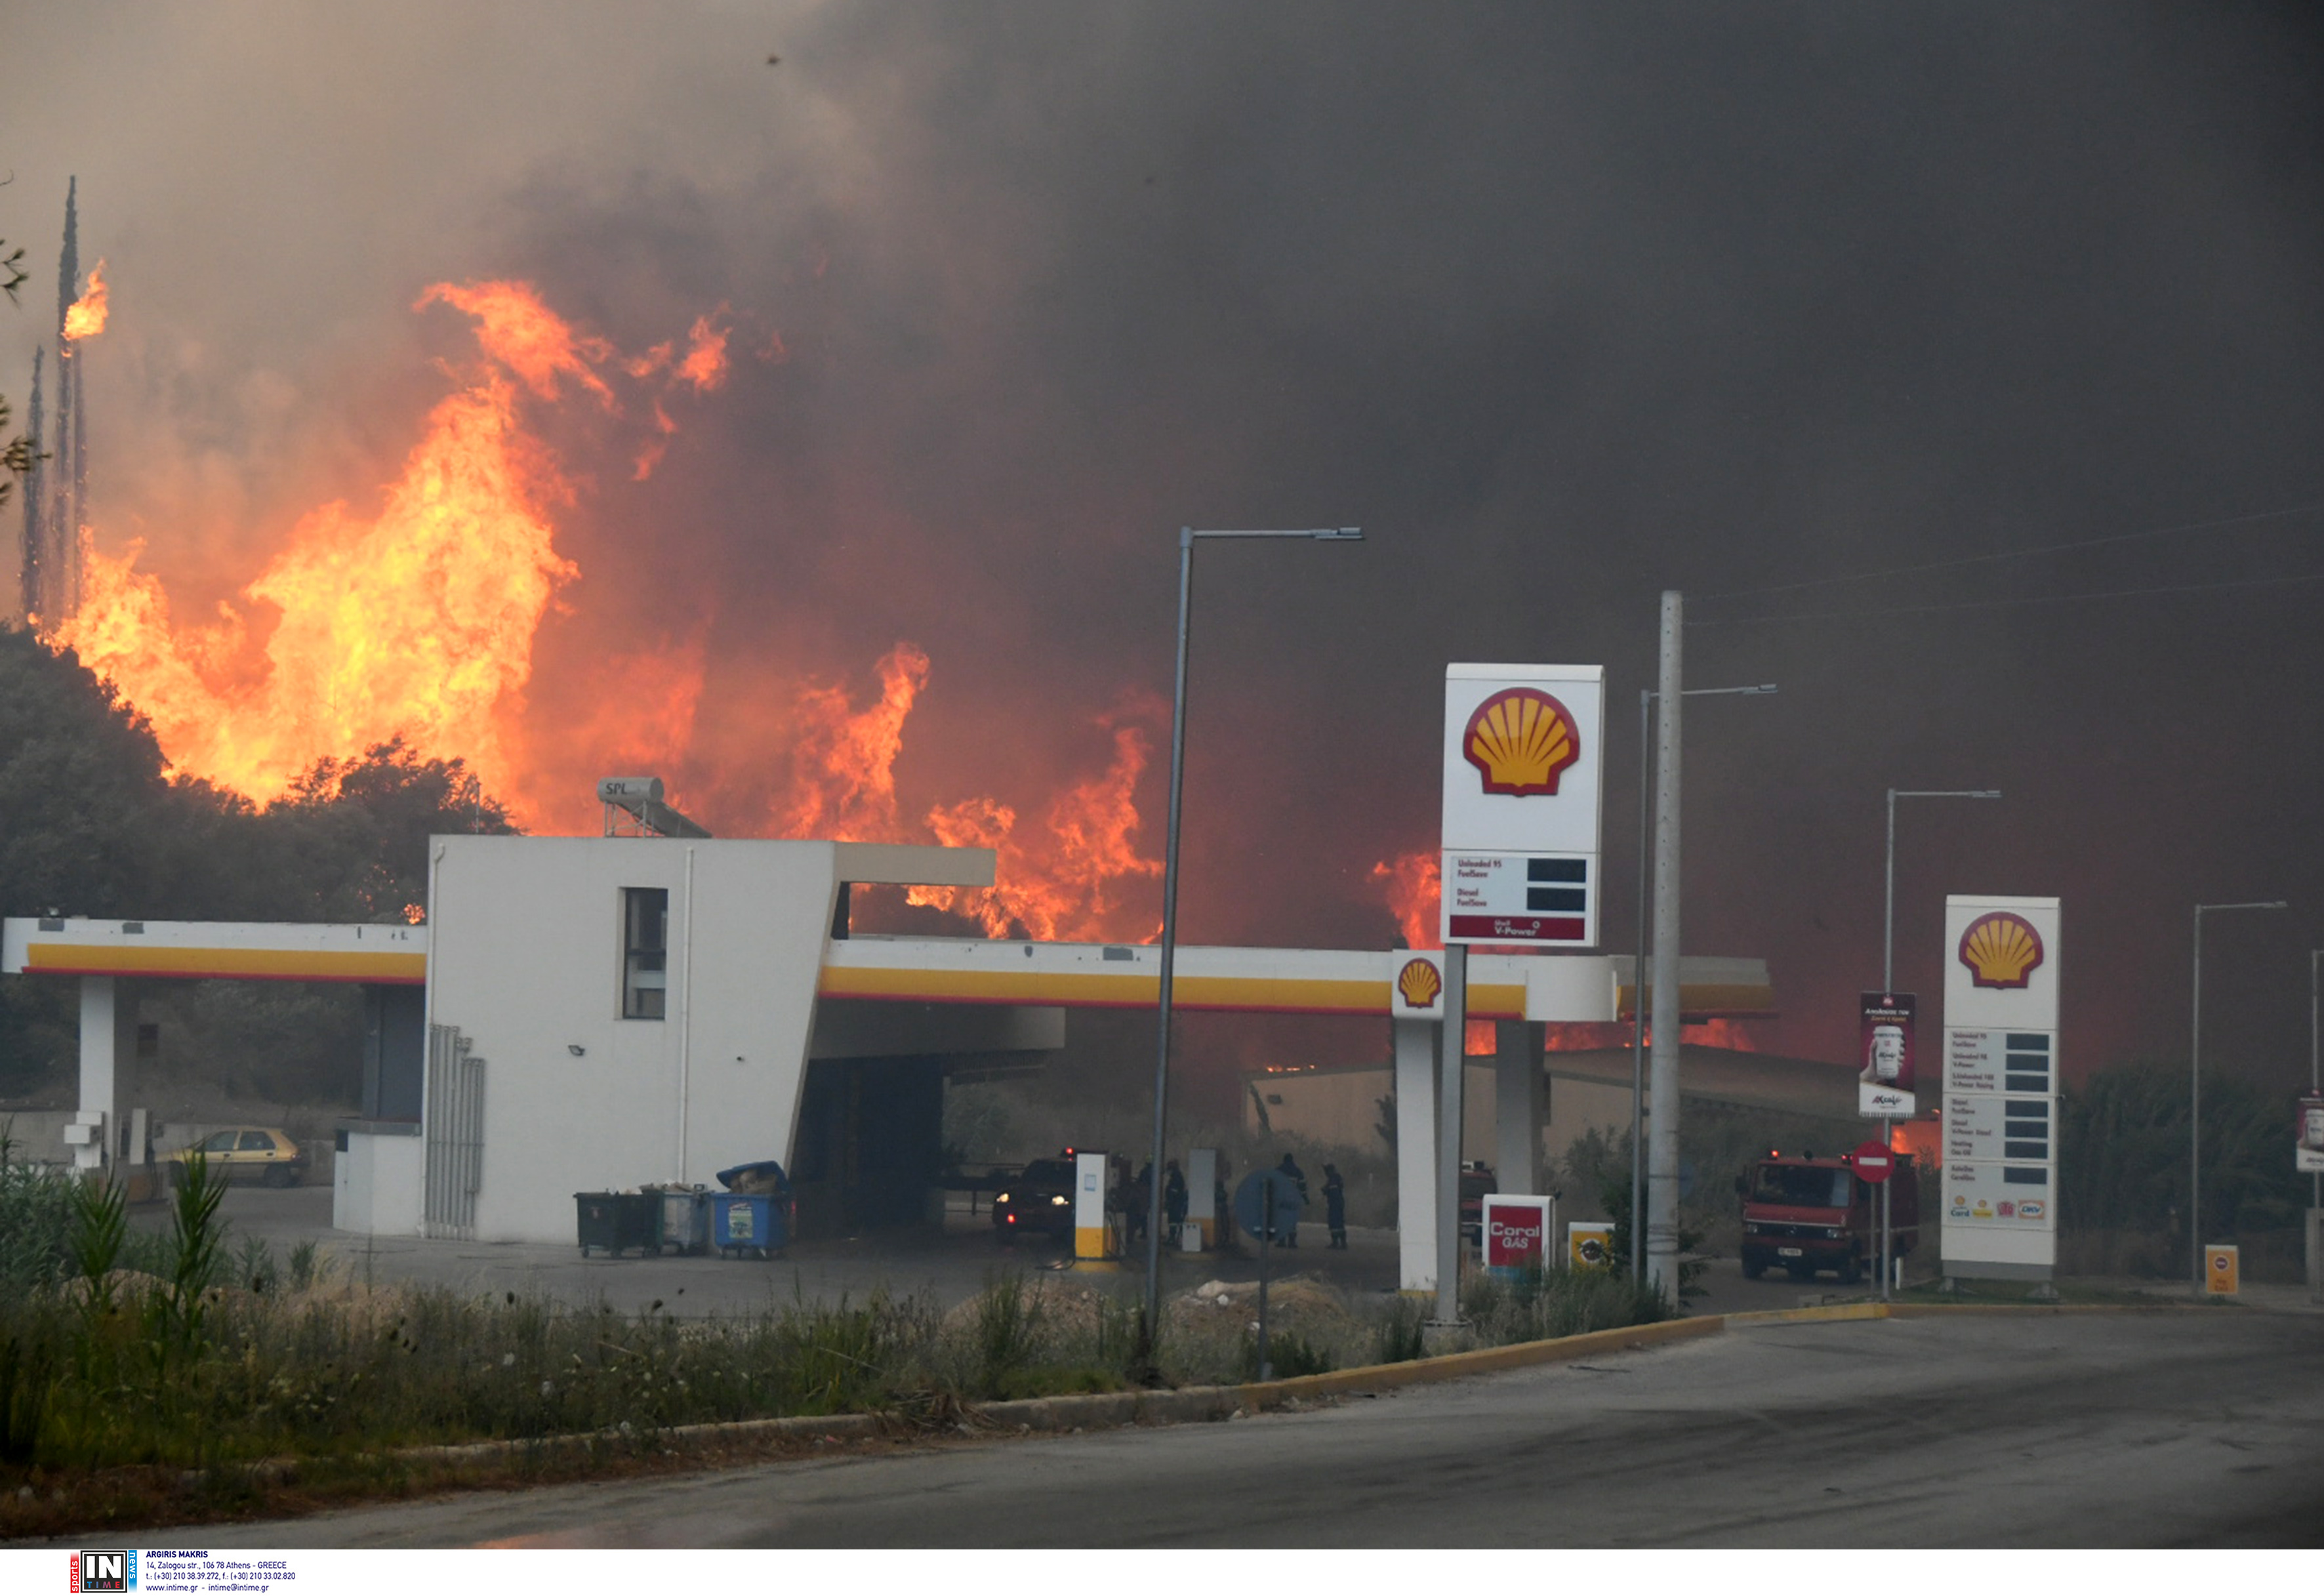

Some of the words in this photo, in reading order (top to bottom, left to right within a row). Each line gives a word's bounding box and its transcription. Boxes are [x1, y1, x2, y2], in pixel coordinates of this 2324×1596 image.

[1458, 859, 1491, 868] Unleaded
[1458, 869, 1488, 878] FuelSave
[1495, 926, 1536, 936] V-Power
[1490, 1221, 1539, 1237] Coral
